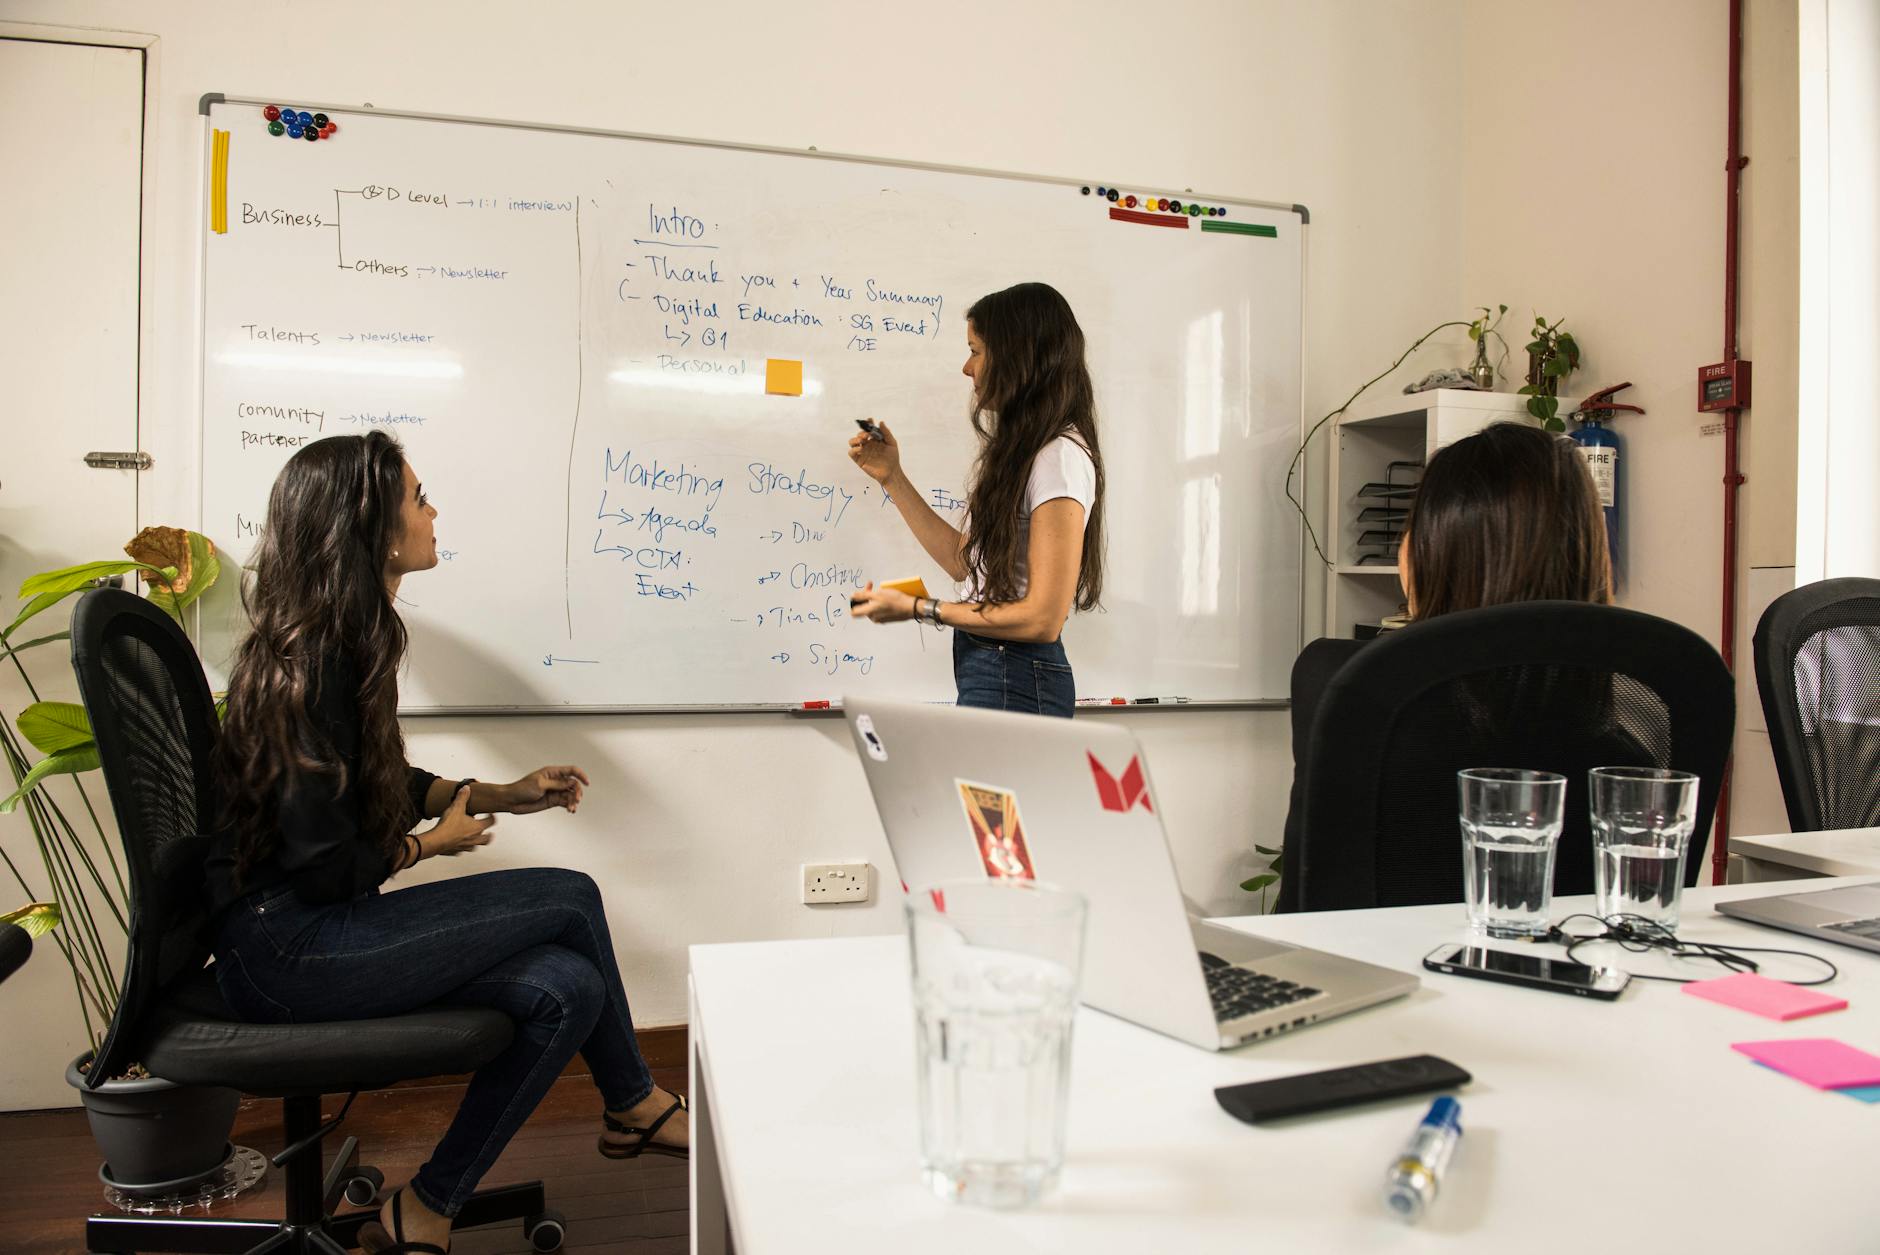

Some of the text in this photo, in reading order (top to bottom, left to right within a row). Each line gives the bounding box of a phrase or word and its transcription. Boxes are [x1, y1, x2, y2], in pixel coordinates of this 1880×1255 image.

[408, 190, 449, 208] Level
[508, 199, 573, 212] interview
[242, 203, 322, 228] Business
[355, 259, 509, 281] Others Newsletter
[645, 255, 724, 283] Thank
[741, 274, 776, 298] you
[821, 275, 852, 300] Year
[866, 279, 944, 312] Summary
[654, 295, 720, 325] Digital
[739, 303, 824, 327] Education
[850, 313, 874, 331] SG
[241, 323, 436, 346] Talents Newsletter
[656, 354, 747, 377] Personal
[1706, 365, 1727, 377] FIRE
[1587, 454, 1609, 464] FIRE
[605, 447, 725, 512] Marketing
[635, 573, 700, 602] Event
